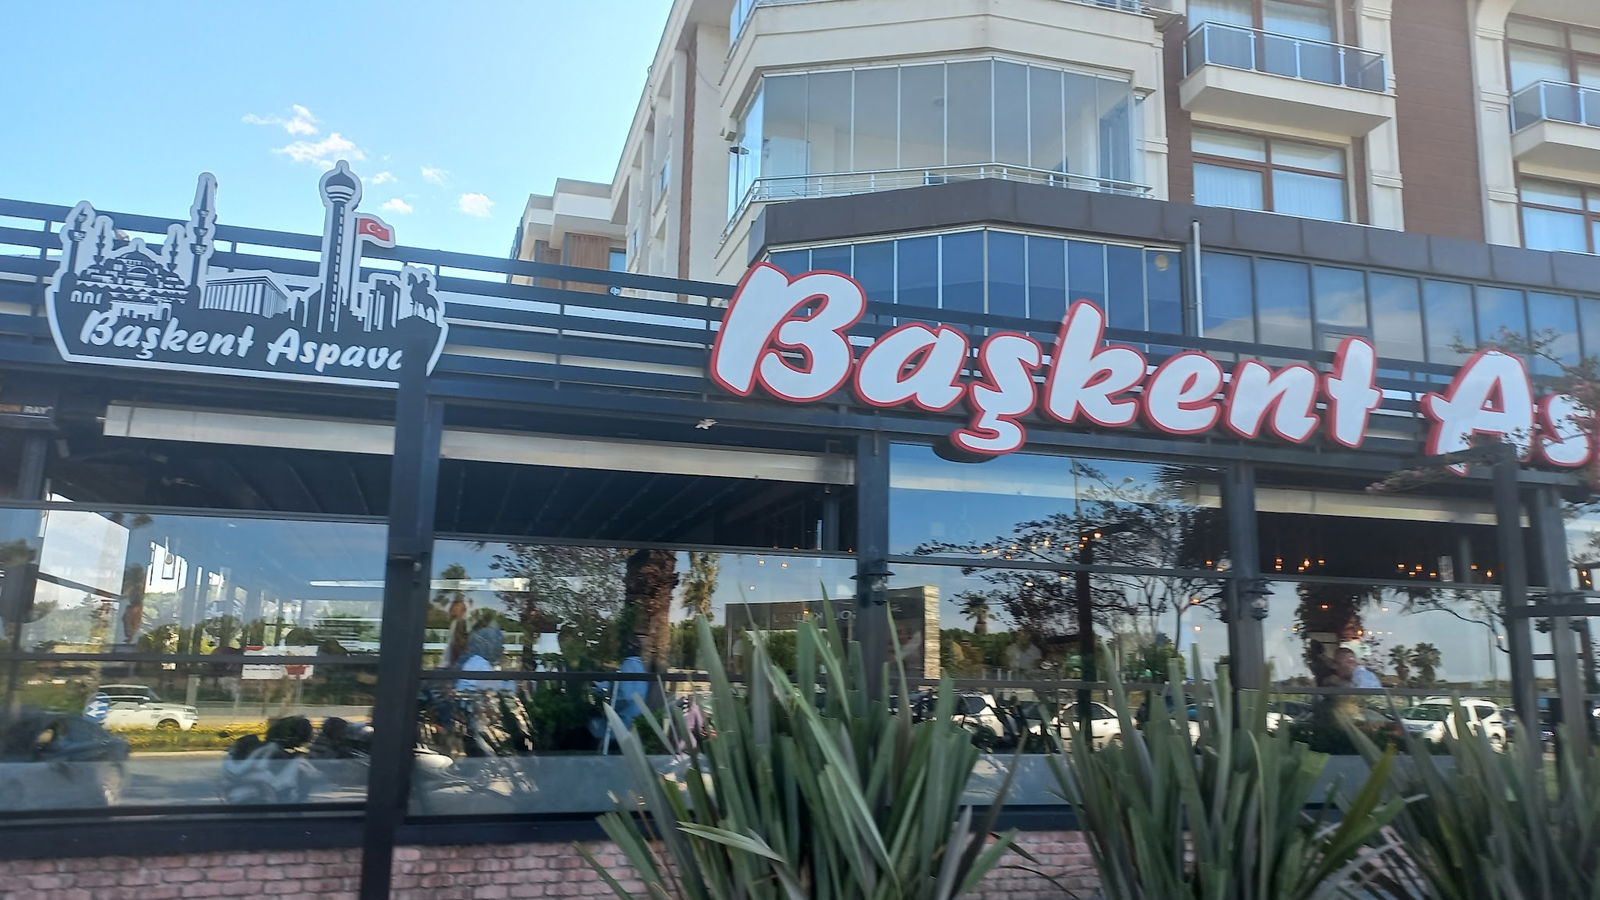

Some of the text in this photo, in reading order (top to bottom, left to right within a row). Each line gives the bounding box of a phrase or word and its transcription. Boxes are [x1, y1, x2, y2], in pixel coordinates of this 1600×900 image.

[80, 309, 254, 359] Başkent
[711, 261, 1600, 476] Başkent As
